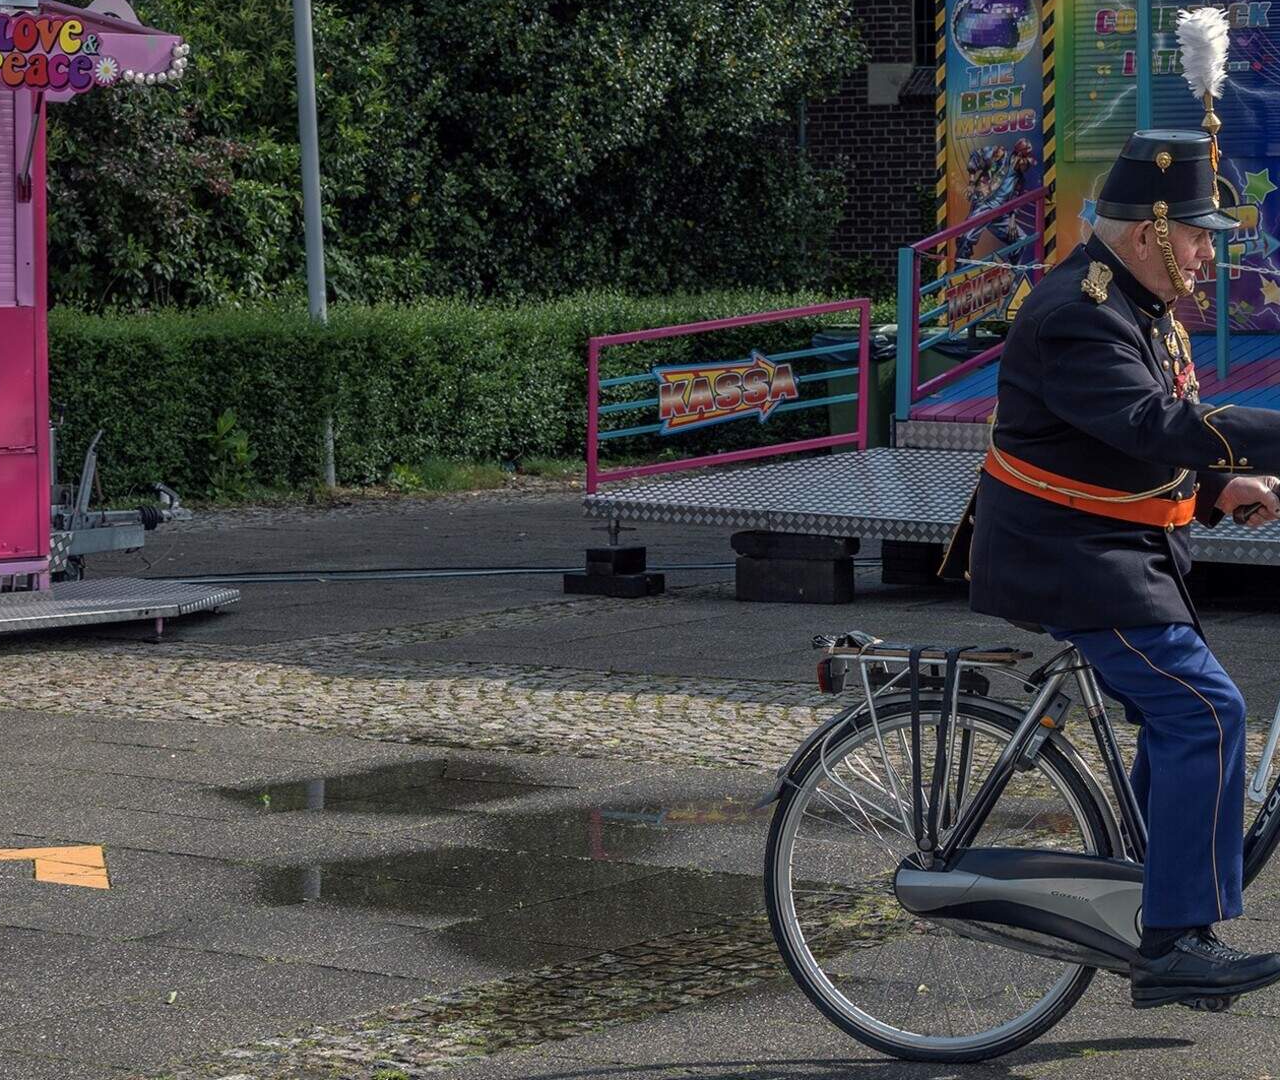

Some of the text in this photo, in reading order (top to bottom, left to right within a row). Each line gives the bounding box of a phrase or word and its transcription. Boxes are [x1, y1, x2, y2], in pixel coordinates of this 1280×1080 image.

[82, 34, 99, 56] &
[965, 62, 1014, 88] THE
[960, 85, 1026, 114] BEST
[955, 109, 1036, 138] MUSIC
[946, 266, 1013, 323] TICKETS
[659, 363, 799, 420] KASSA
